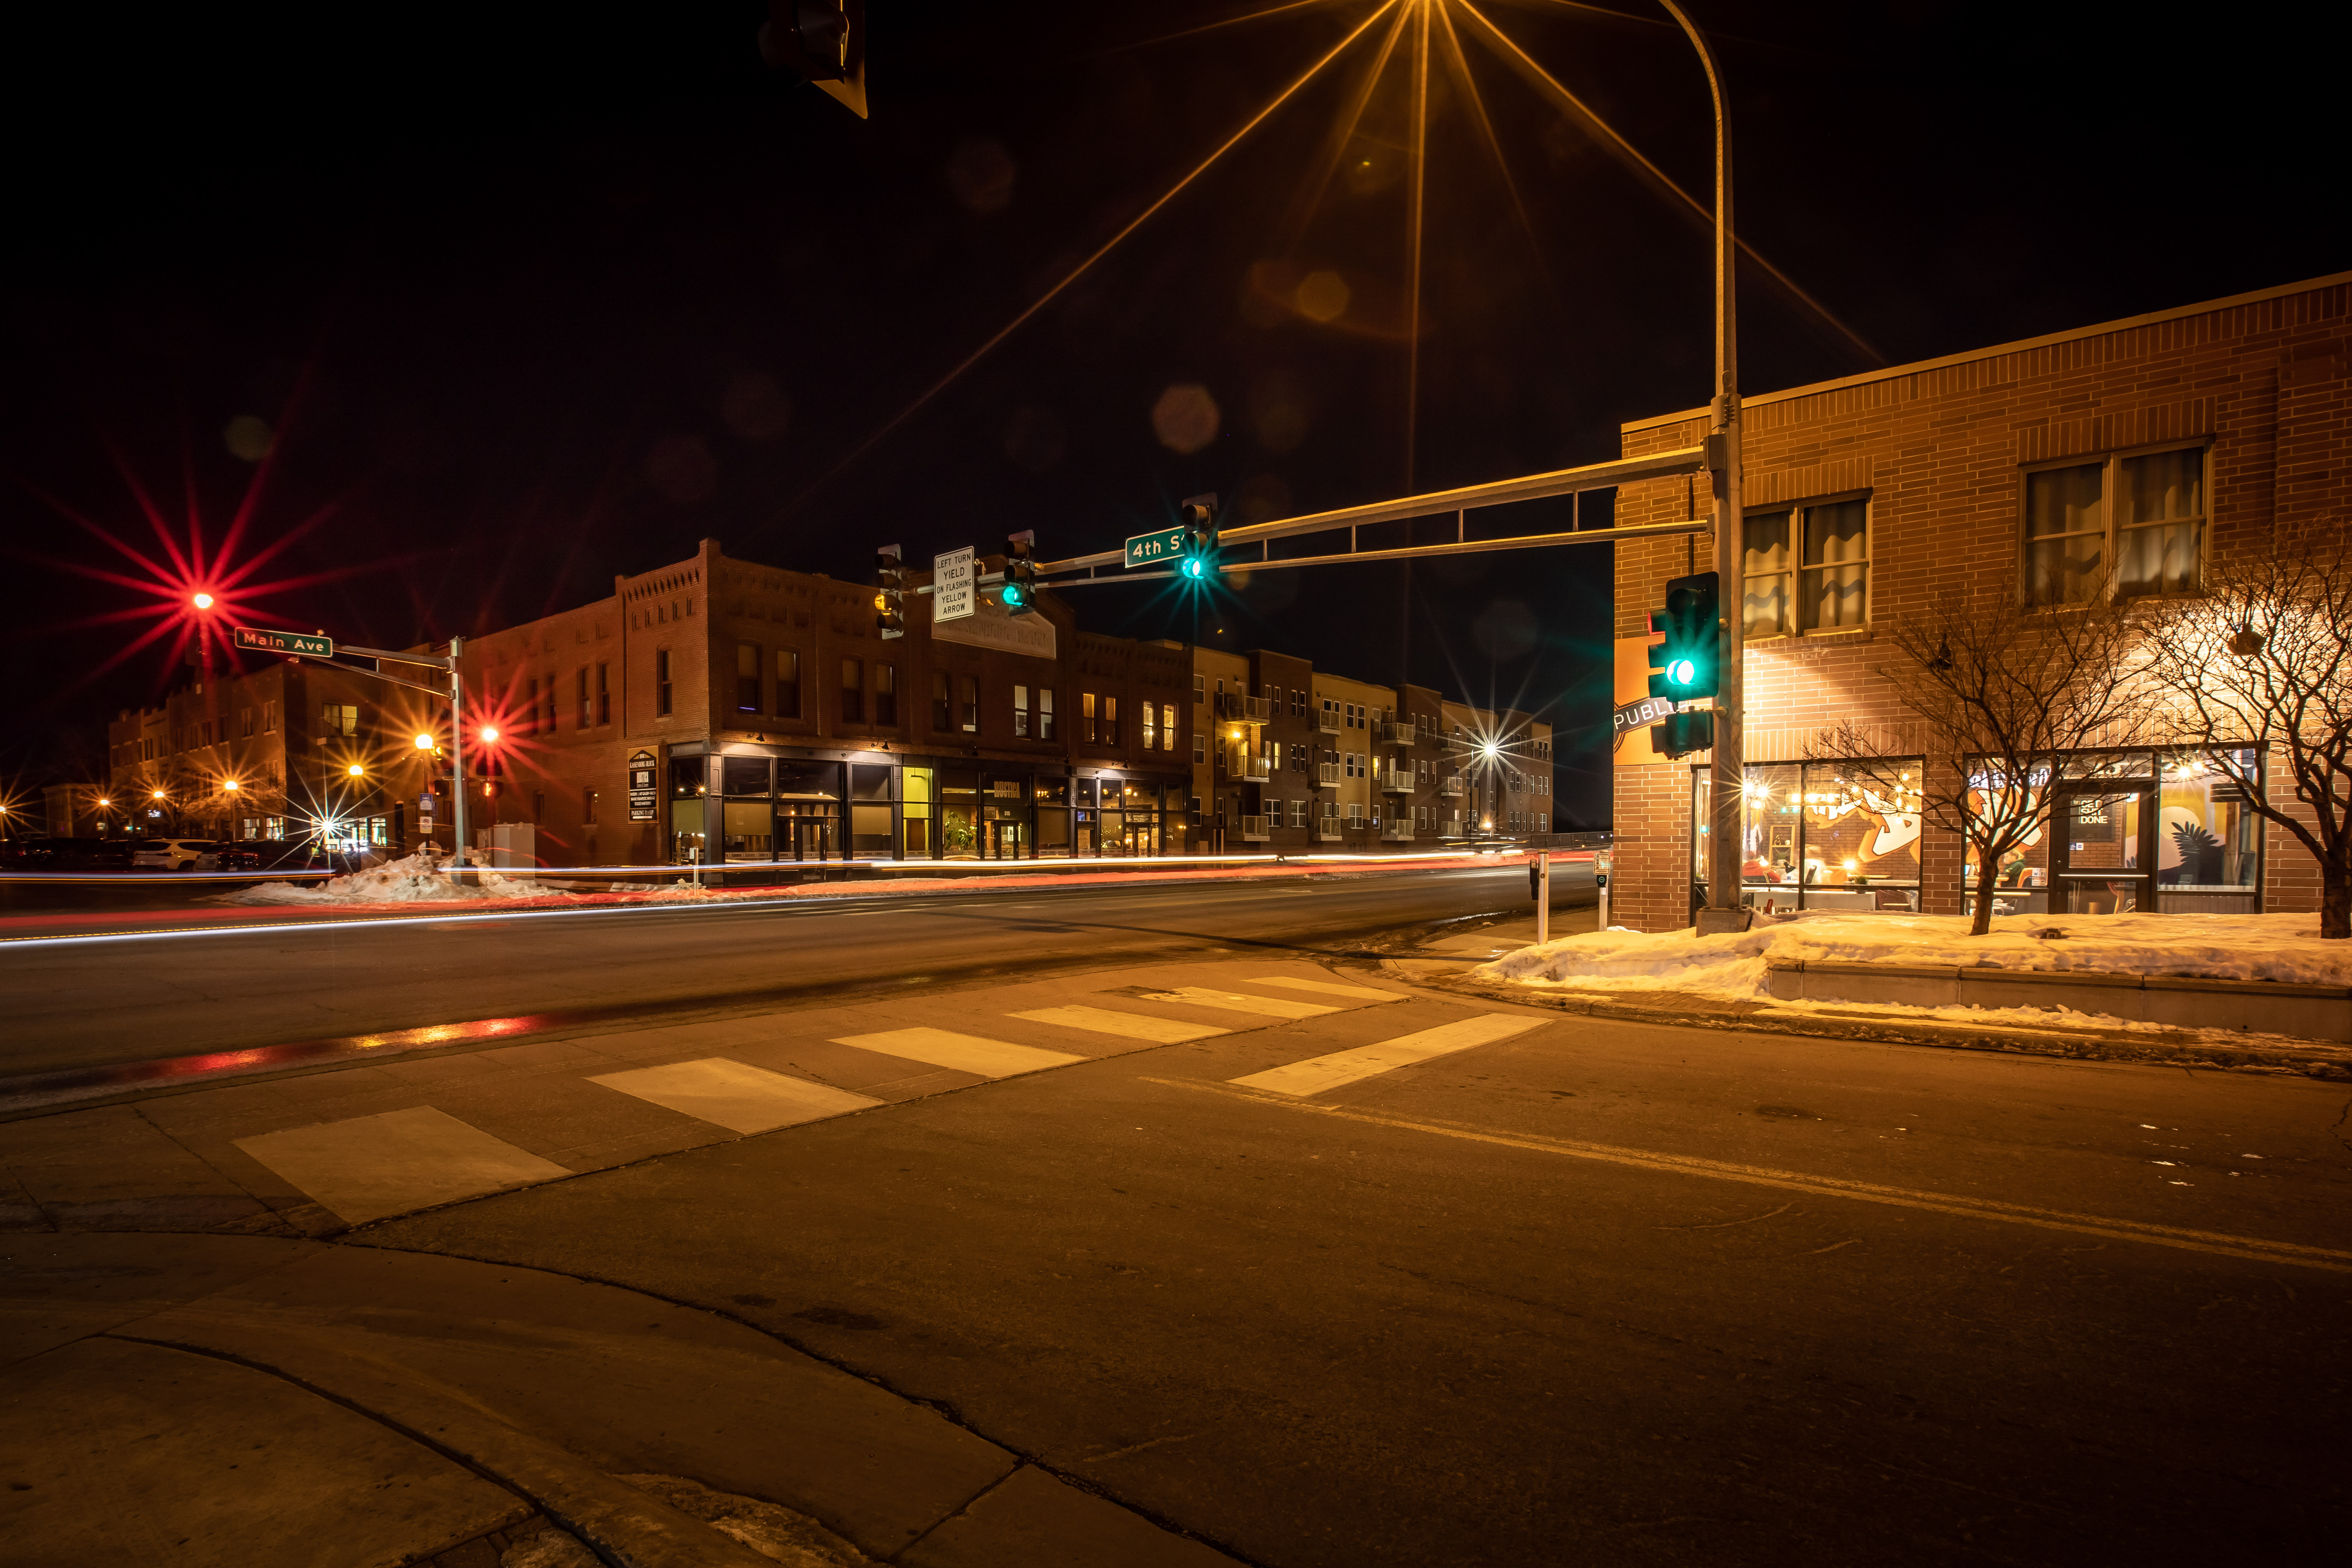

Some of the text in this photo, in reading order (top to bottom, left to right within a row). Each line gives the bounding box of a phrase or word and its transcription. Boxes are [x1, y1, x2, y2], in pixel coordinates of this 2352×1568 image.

[1133, 540, 1161, 557] 4th
[937, 552, 971, 569] LEFT TURN
[943, 567, 965, 580] YIELD
[937, 578, 972, 594] ON FLASHING
[941, 591, 967, 604] YELLOW
[943, 603, 965, 615] ARROW
[243, 633, 324, 651] Main Ave
[1614, 701, 1687, 730] PUBLI
[994, 781, 1020, 798] RUSTICA
